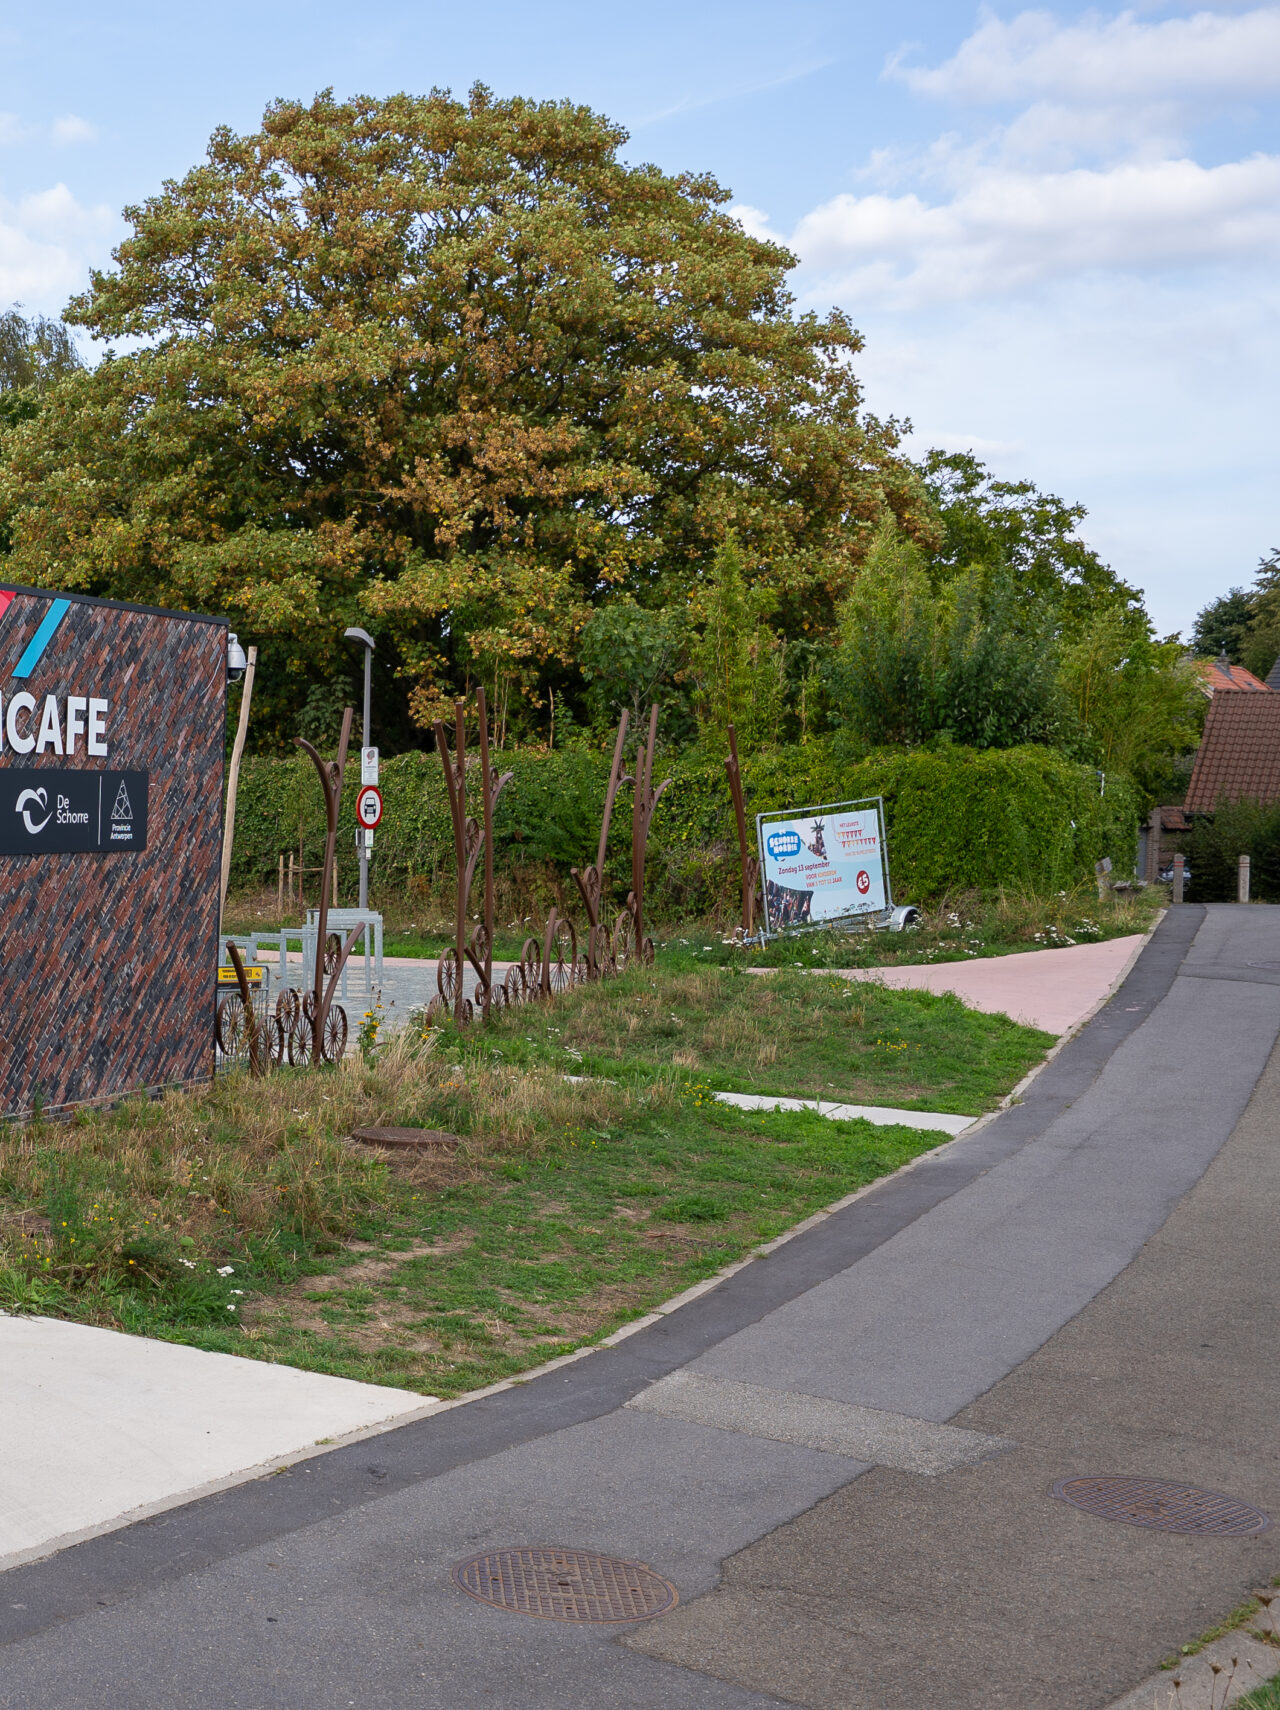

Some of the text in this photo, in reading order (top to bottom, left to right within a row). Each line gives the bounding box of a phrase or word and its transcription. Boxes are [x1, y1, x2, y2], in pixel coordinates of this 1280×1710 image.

[57, 794, 70, 809] De
[56, 810, 89, 824] Schorre
[778, 866, 798, 875] Zondag
[804, 861, 830, 871] september
[857, 873, 869, 890] €5
